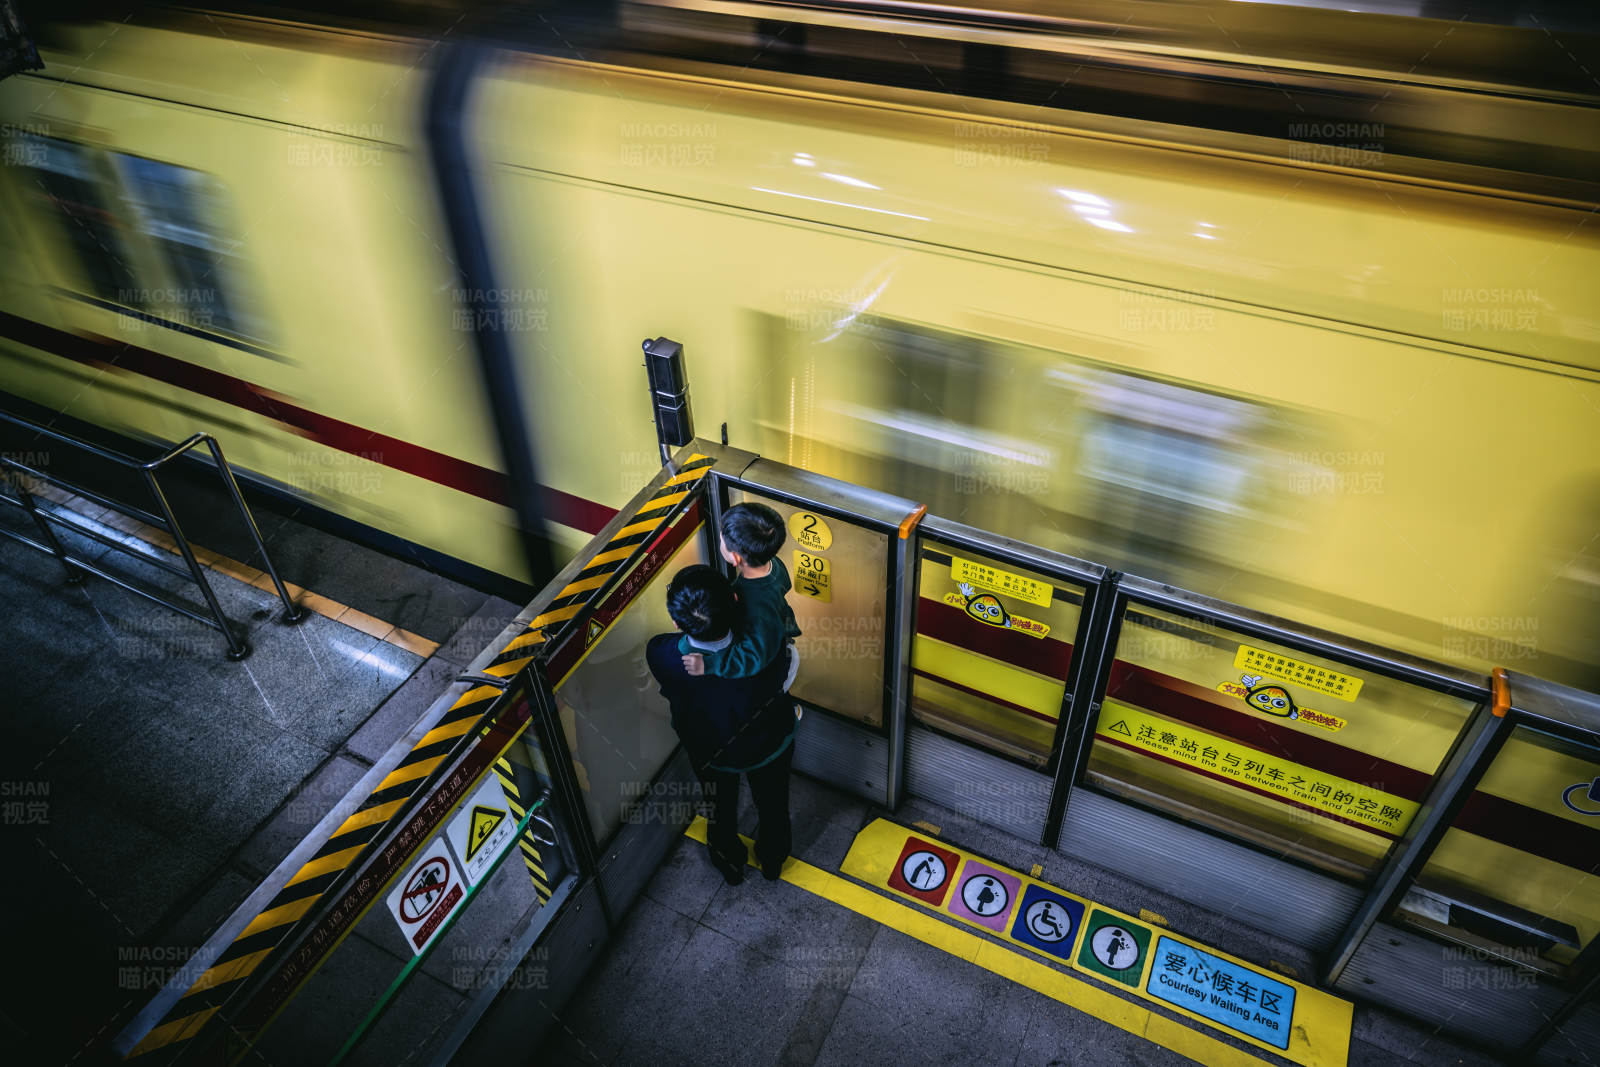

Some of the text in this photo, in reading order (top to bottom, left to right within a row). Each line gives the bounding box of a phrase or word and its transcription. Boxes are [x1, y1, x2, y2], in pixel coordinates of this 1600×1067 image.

[804, 514, 818, 535] 2
[798, 538, 824, 550] Platform
[800, 530, 821, 544] 站台
[800, 554, 824, 572] 30
[797, 567, 828, 583] 屏蔽门
[1223, 684, 1248, 697] 文明
[1136, 736, 1169, 751] Please
[1173, 749, 1197, 761] mind
[1201, 759, 1217, 768] the
[1221, 766, 1240, 776] gap
[1245, 774, 1289, 792] between
[1293, 789, 1317, 801] train
[1322, 800, 1343, 810] and
[1138, 724, 1403, 821] 注意站台与列车之间的空隙
[1164, 952, 1282, 1016] 爱心候车区
[1159, 974, 1279, 1030] Courtesy Waiting Area
